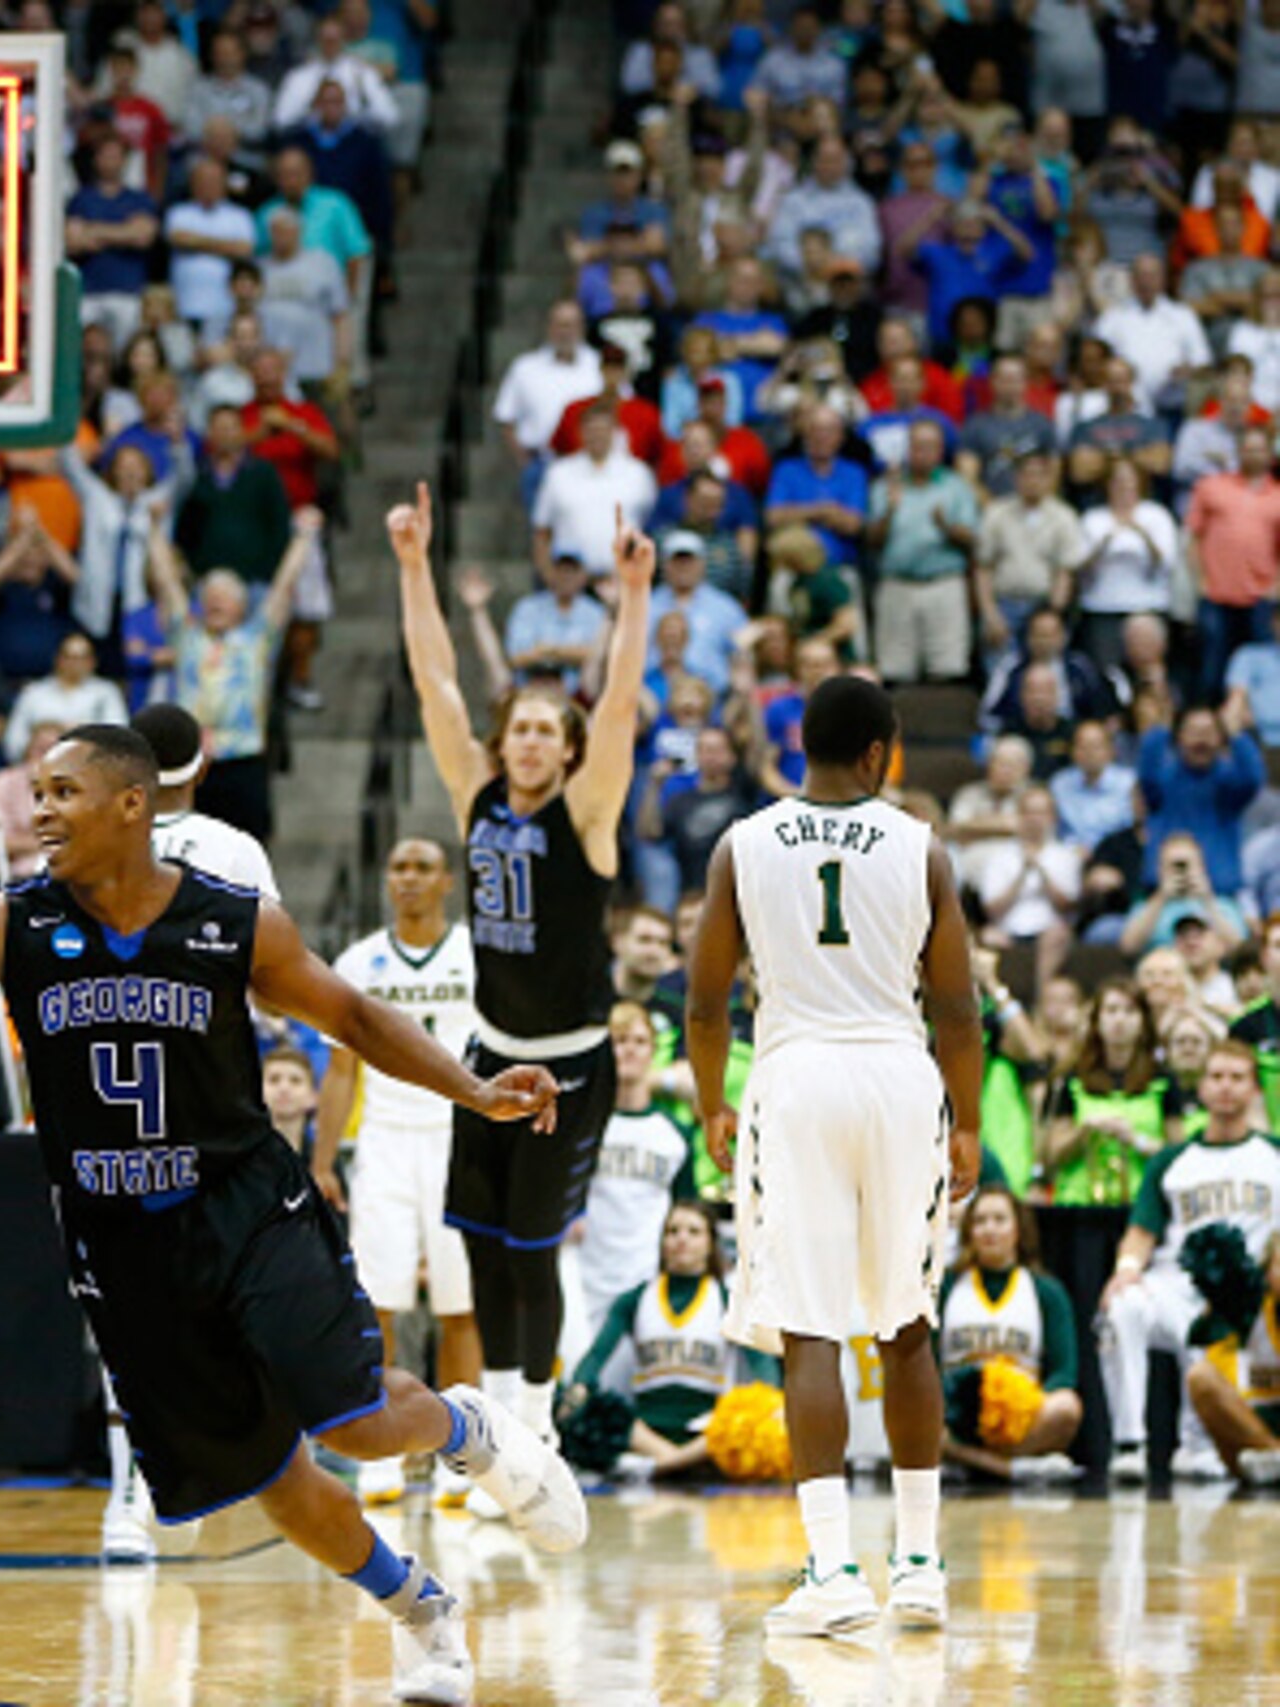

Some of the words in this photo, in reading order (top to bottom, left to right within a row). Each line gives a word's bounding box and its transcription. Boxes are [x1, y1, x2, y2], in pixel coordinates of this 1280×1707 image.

[774, 814, 885, 854] CHERY
[469, 848, 533, 919] 31
[817, 858, 851, 945] 1
[38, 974, 212, 1035] GEORGIA
[90, 1042, 166, 1139] 4
[73, 1145, 199, 1195] STATE
